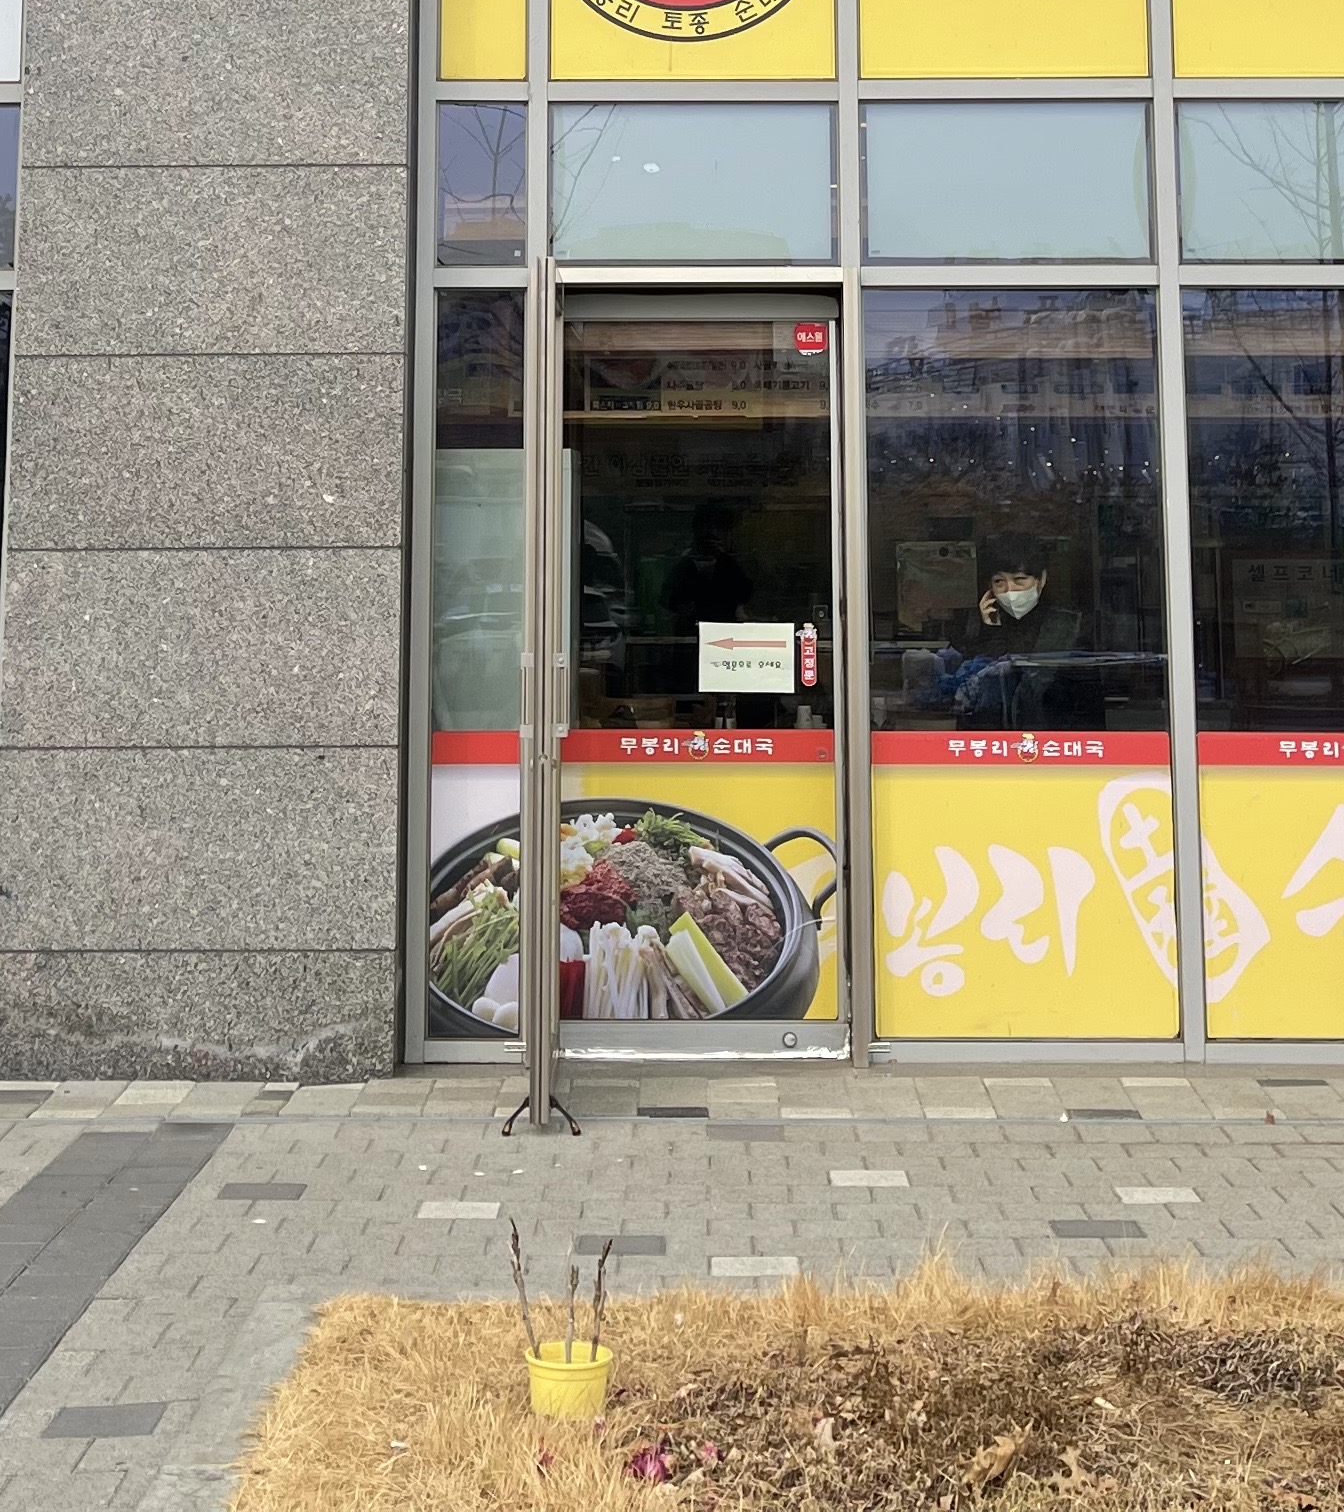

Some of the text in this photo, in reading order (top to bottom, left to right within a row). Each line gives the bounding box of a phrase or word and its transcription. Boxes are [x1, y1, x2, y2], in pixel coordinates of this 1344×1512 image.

[661, 11, 710, 35] 토종
[803, 646, 814, 680] 고정문
[620, 737, 774, 755] 무봉리 순대국
[948, 739, 1104, 758] 무봉리 순대국
[1279, 740, 1339, 759] 무봉리
